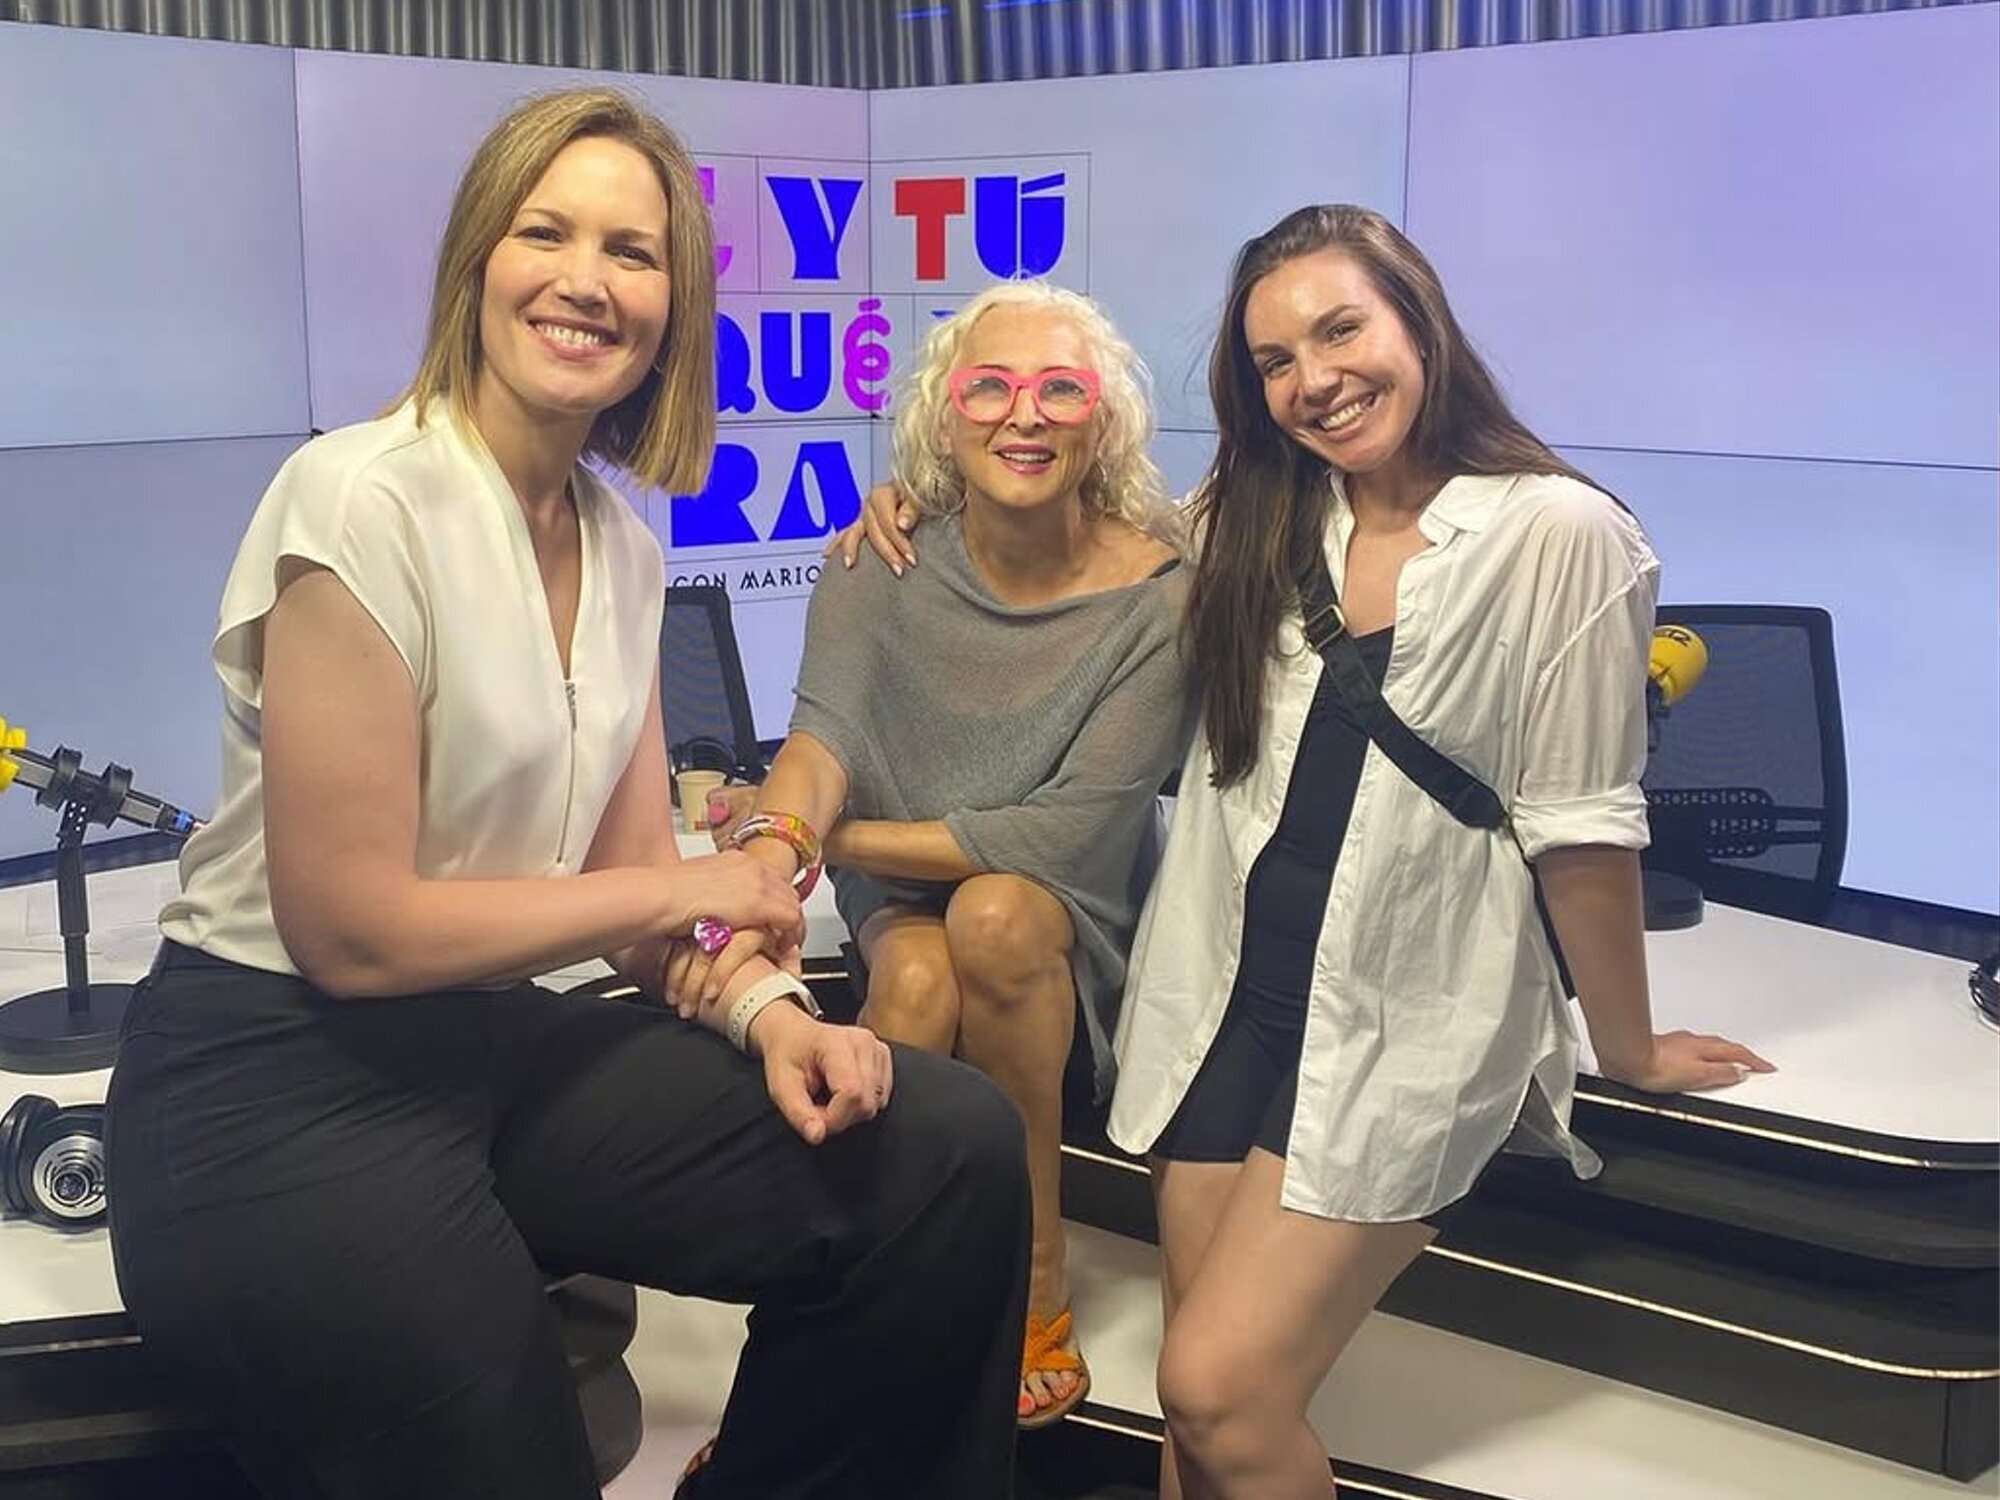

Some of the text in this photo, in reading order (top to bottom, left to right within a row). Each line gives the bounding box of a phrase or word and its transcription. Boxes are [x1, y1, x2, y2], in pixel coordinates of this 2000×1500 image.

[894, 172, 1066, 281] TÚ
[672, 565, 822, 590] CON MARIO
